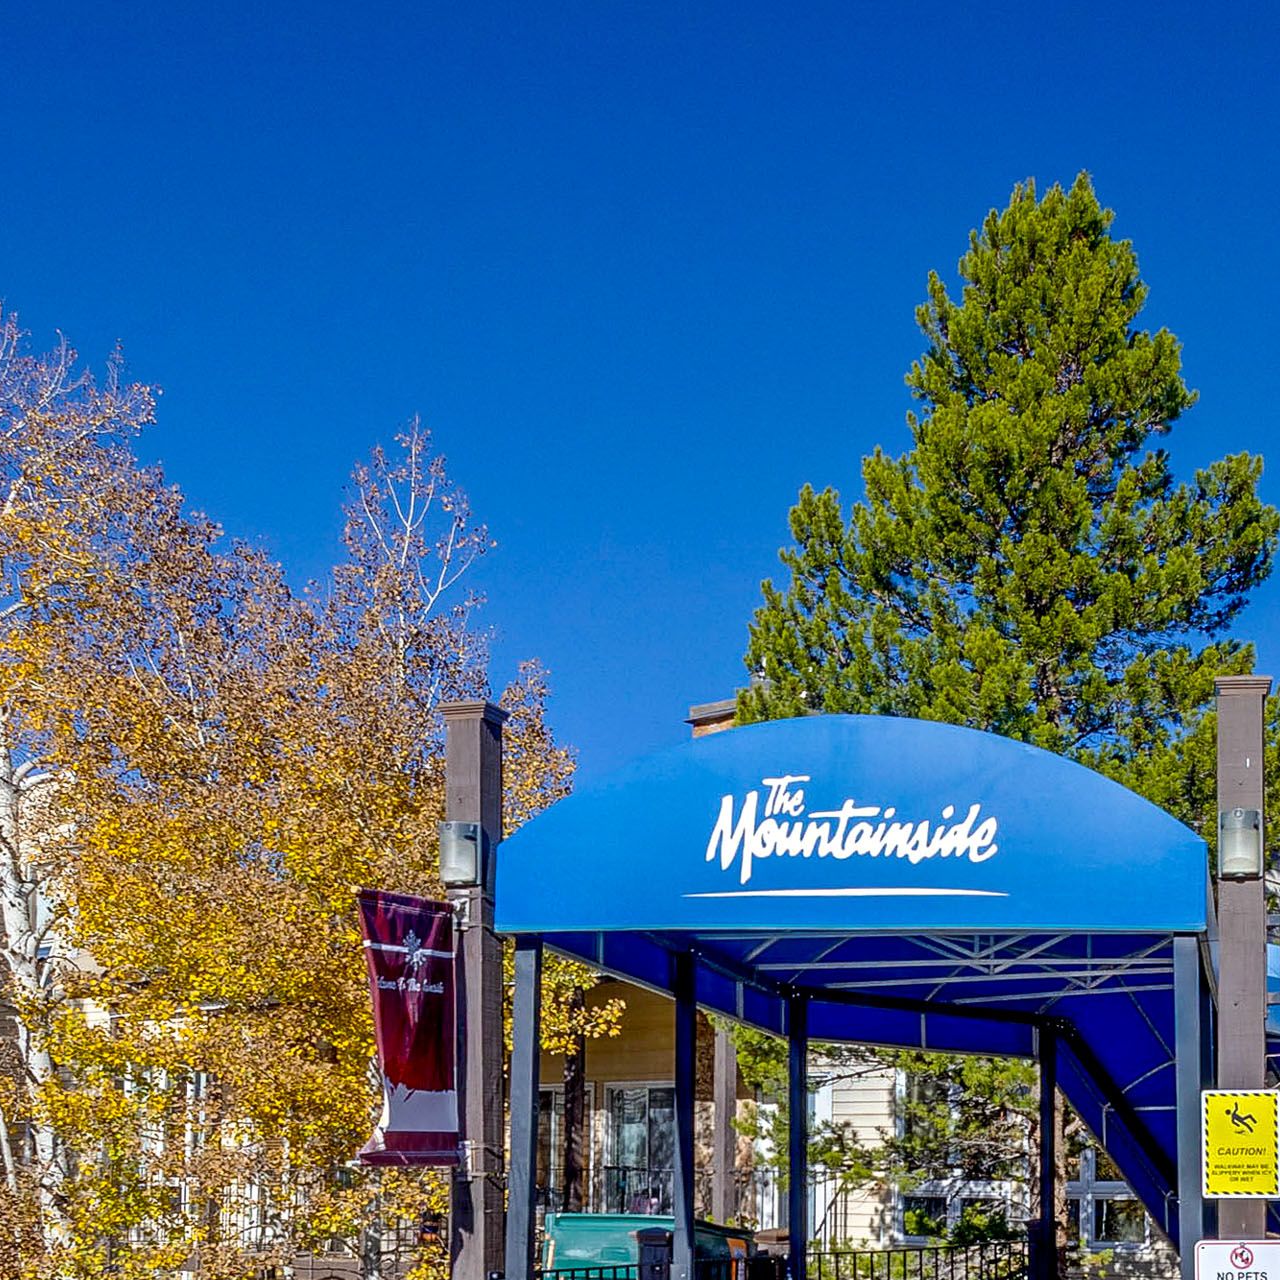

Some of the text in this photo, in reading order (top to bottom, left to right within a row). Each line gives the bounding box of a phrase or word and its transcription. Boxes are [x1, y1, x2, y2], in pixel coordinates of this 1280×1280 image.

[762, 775, 810, 816] The
[705, 790, 998, 884] Mountainside
[1217, 1147, 1267, 1156] CAUTION!
